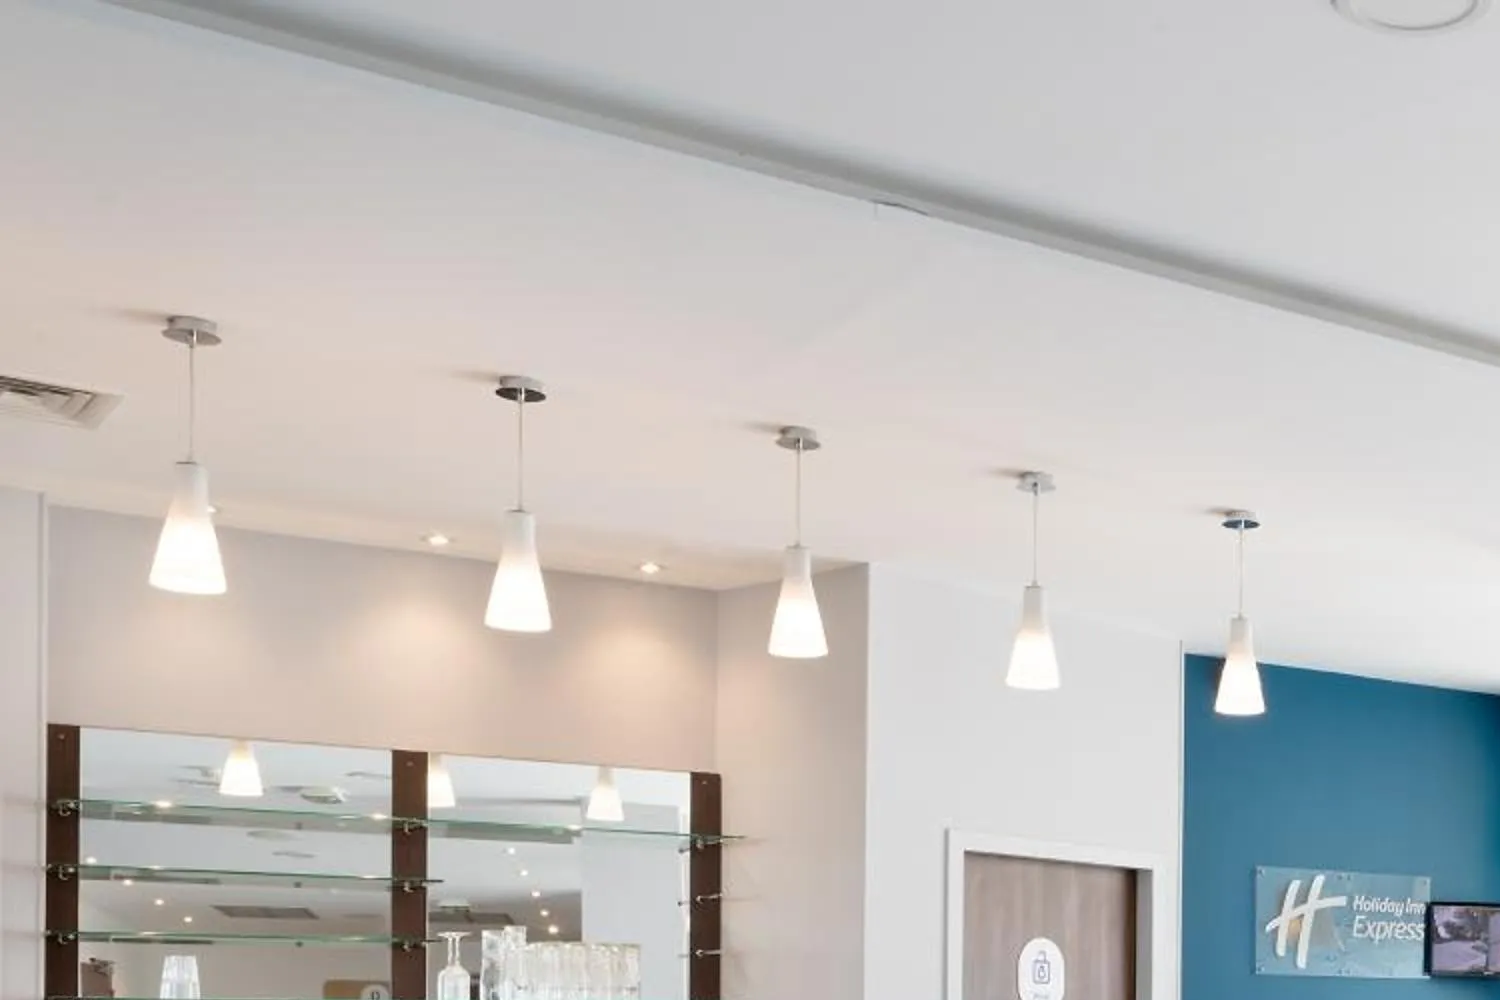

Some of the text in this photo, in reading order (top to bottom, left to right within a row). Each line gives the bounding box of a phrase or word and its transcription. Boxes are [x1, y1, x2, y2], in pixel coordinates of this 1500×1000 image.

[1353, 895, 1426, 917] Holiday Inn
[1352, 915, 1425, 944] Express
